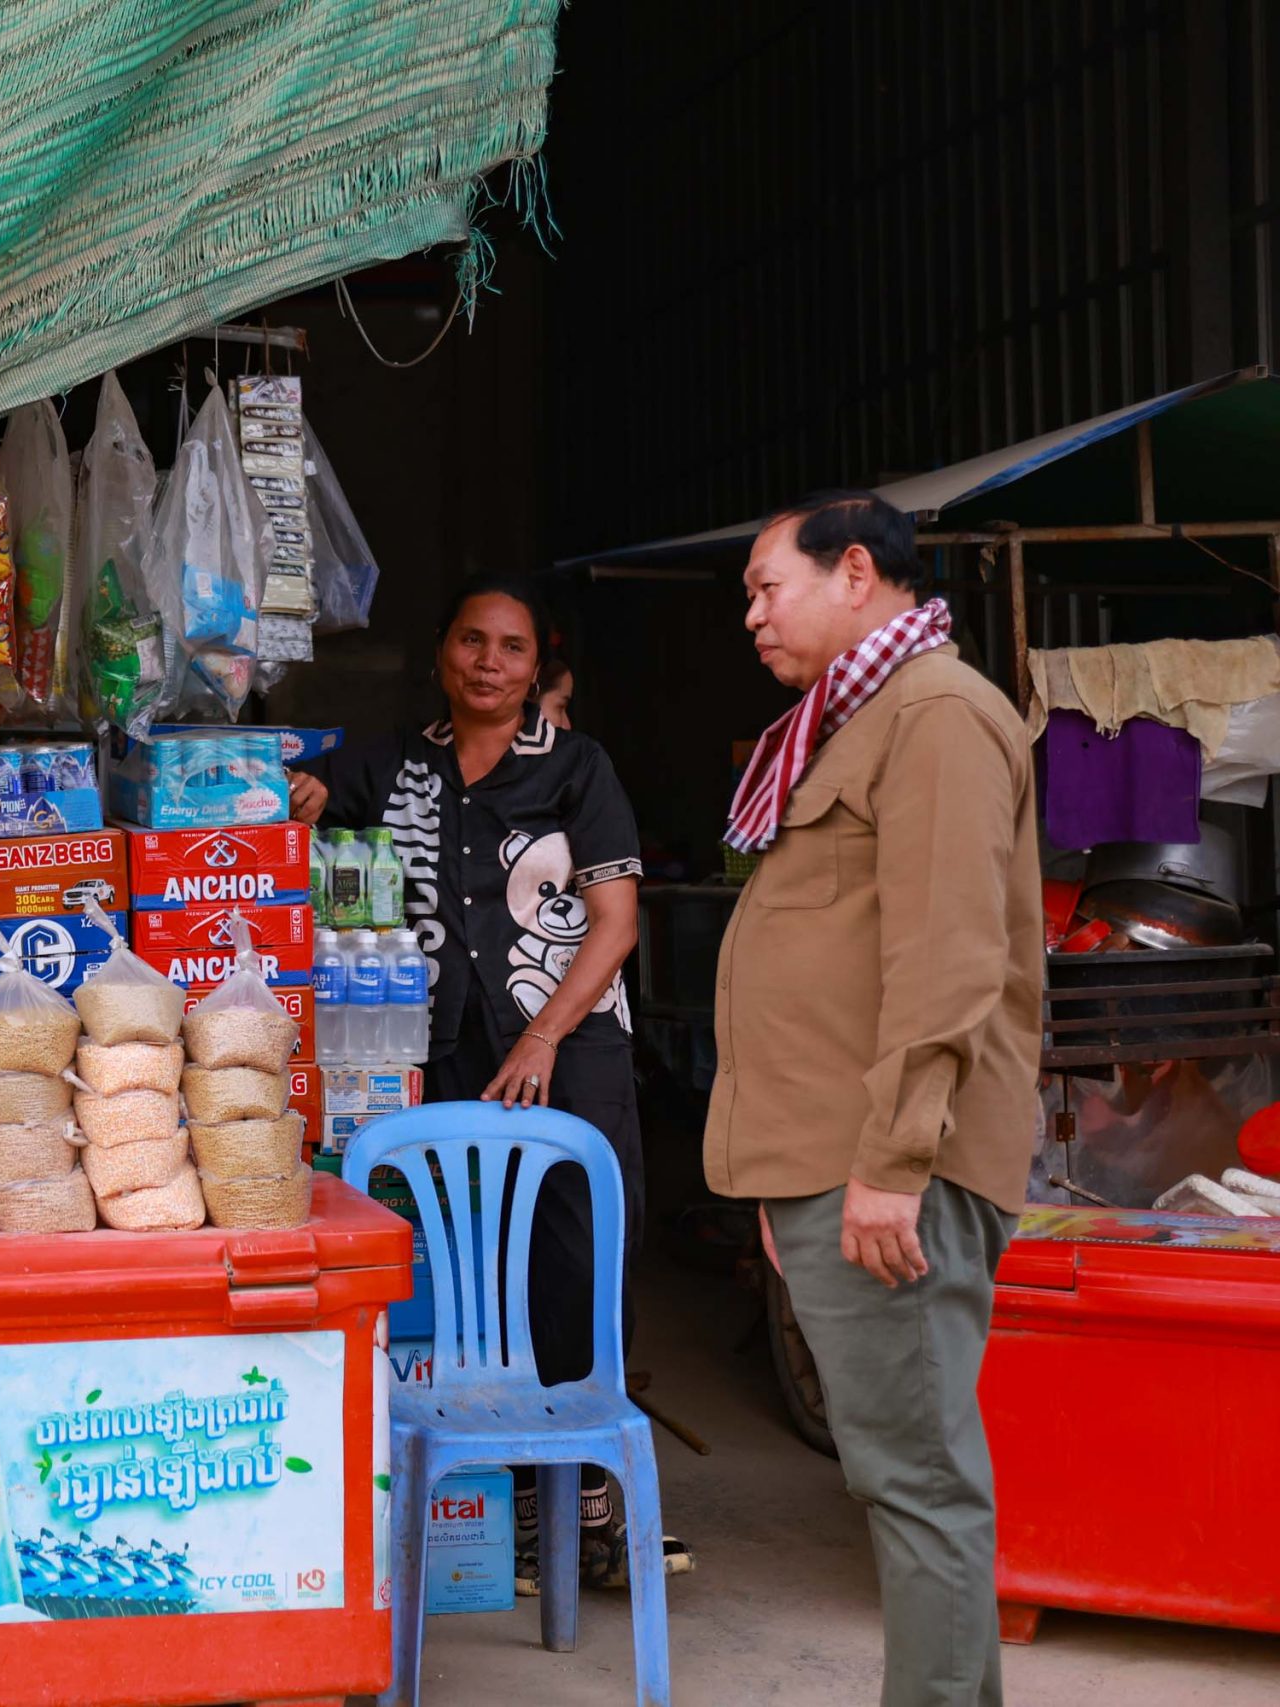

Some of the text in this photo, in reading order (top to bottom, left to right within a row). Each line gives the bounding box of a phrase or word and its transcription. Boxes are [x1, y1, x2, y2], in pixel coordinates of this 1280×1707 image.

[161, 805, 199, 817] Energy
[163, 874, 276, 902] ANCHOR
[167, 955, 279, 983] ANCHR
[431, 1489, 485, 1520] ital
[581, 1496, 608, 1517] HINO
[432, 1520, 485, 1529] Premium Water
[199, 1573, 276, 1590] ICY COOL
